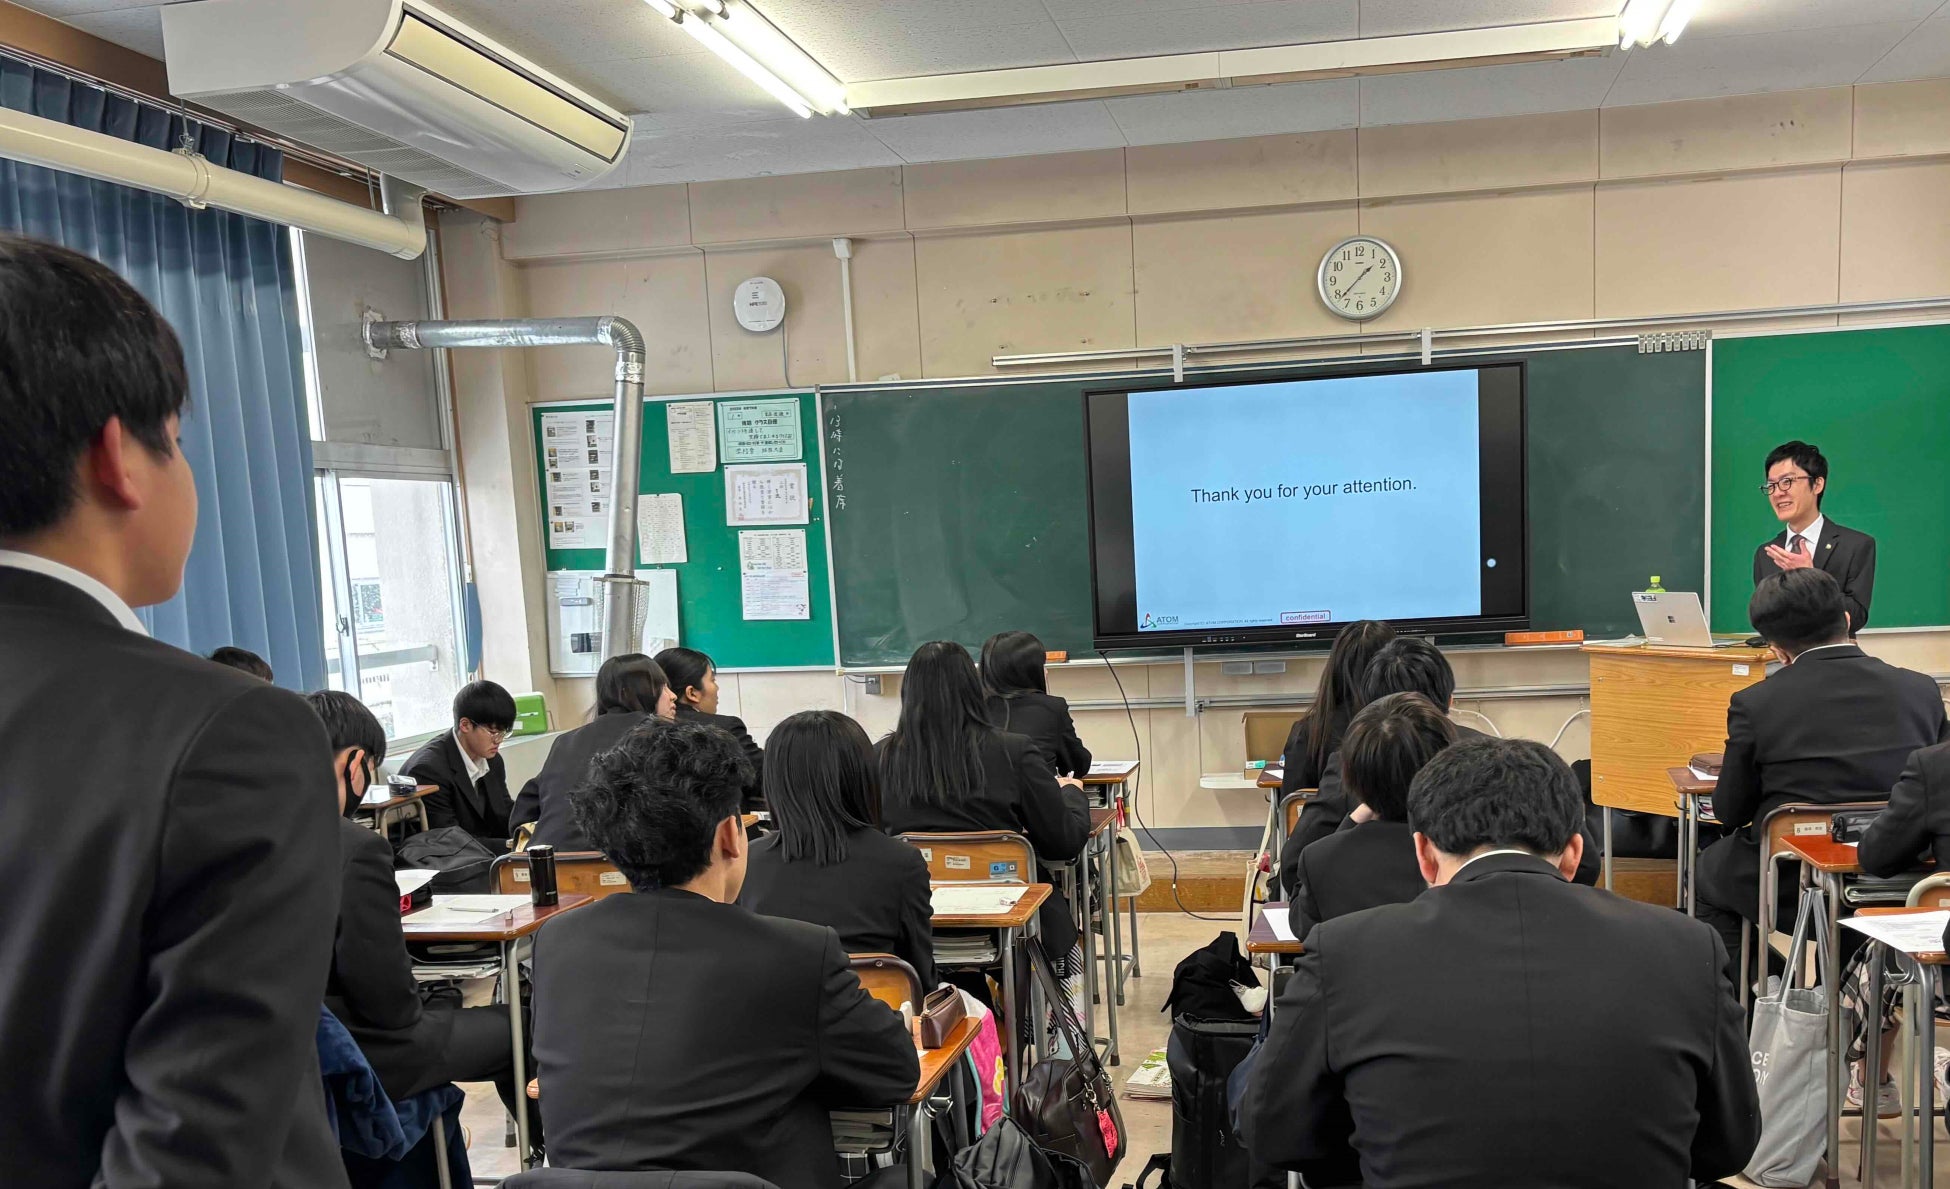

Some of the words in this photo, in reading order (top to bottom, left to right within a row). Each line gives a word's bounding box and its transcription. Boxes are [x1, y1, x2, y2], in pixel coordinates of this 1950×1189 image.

[1343, 250, 1350, 261] 11
[1355, 246, 1364, 257] 12
[1333, 261, 1343, 271] 10
[1380, 258, 1386, 269] 2
[1329, 276, 1337, 286] 9
[1384, 272, 1391, 282] 3
[1334, 289, 1341, 299] 8
[1379, 286, 1385, 295] 4
[1344, 298, 1351, 308] 7
[1356, 300, 1364, 310] 6
[1370, 297, 1377, 307] 5
[1191, 487, 1240, 503] Thank
[1244, 488, 1272, 504] you
[1277, 484, 1299, 498] for
[1303, 482, 1338, 500] your
[1343, 477, 1417, 494] attention.
[1156, 615, 1179, 623] ATOM
[1285, 613, 1326, 621] confidential
